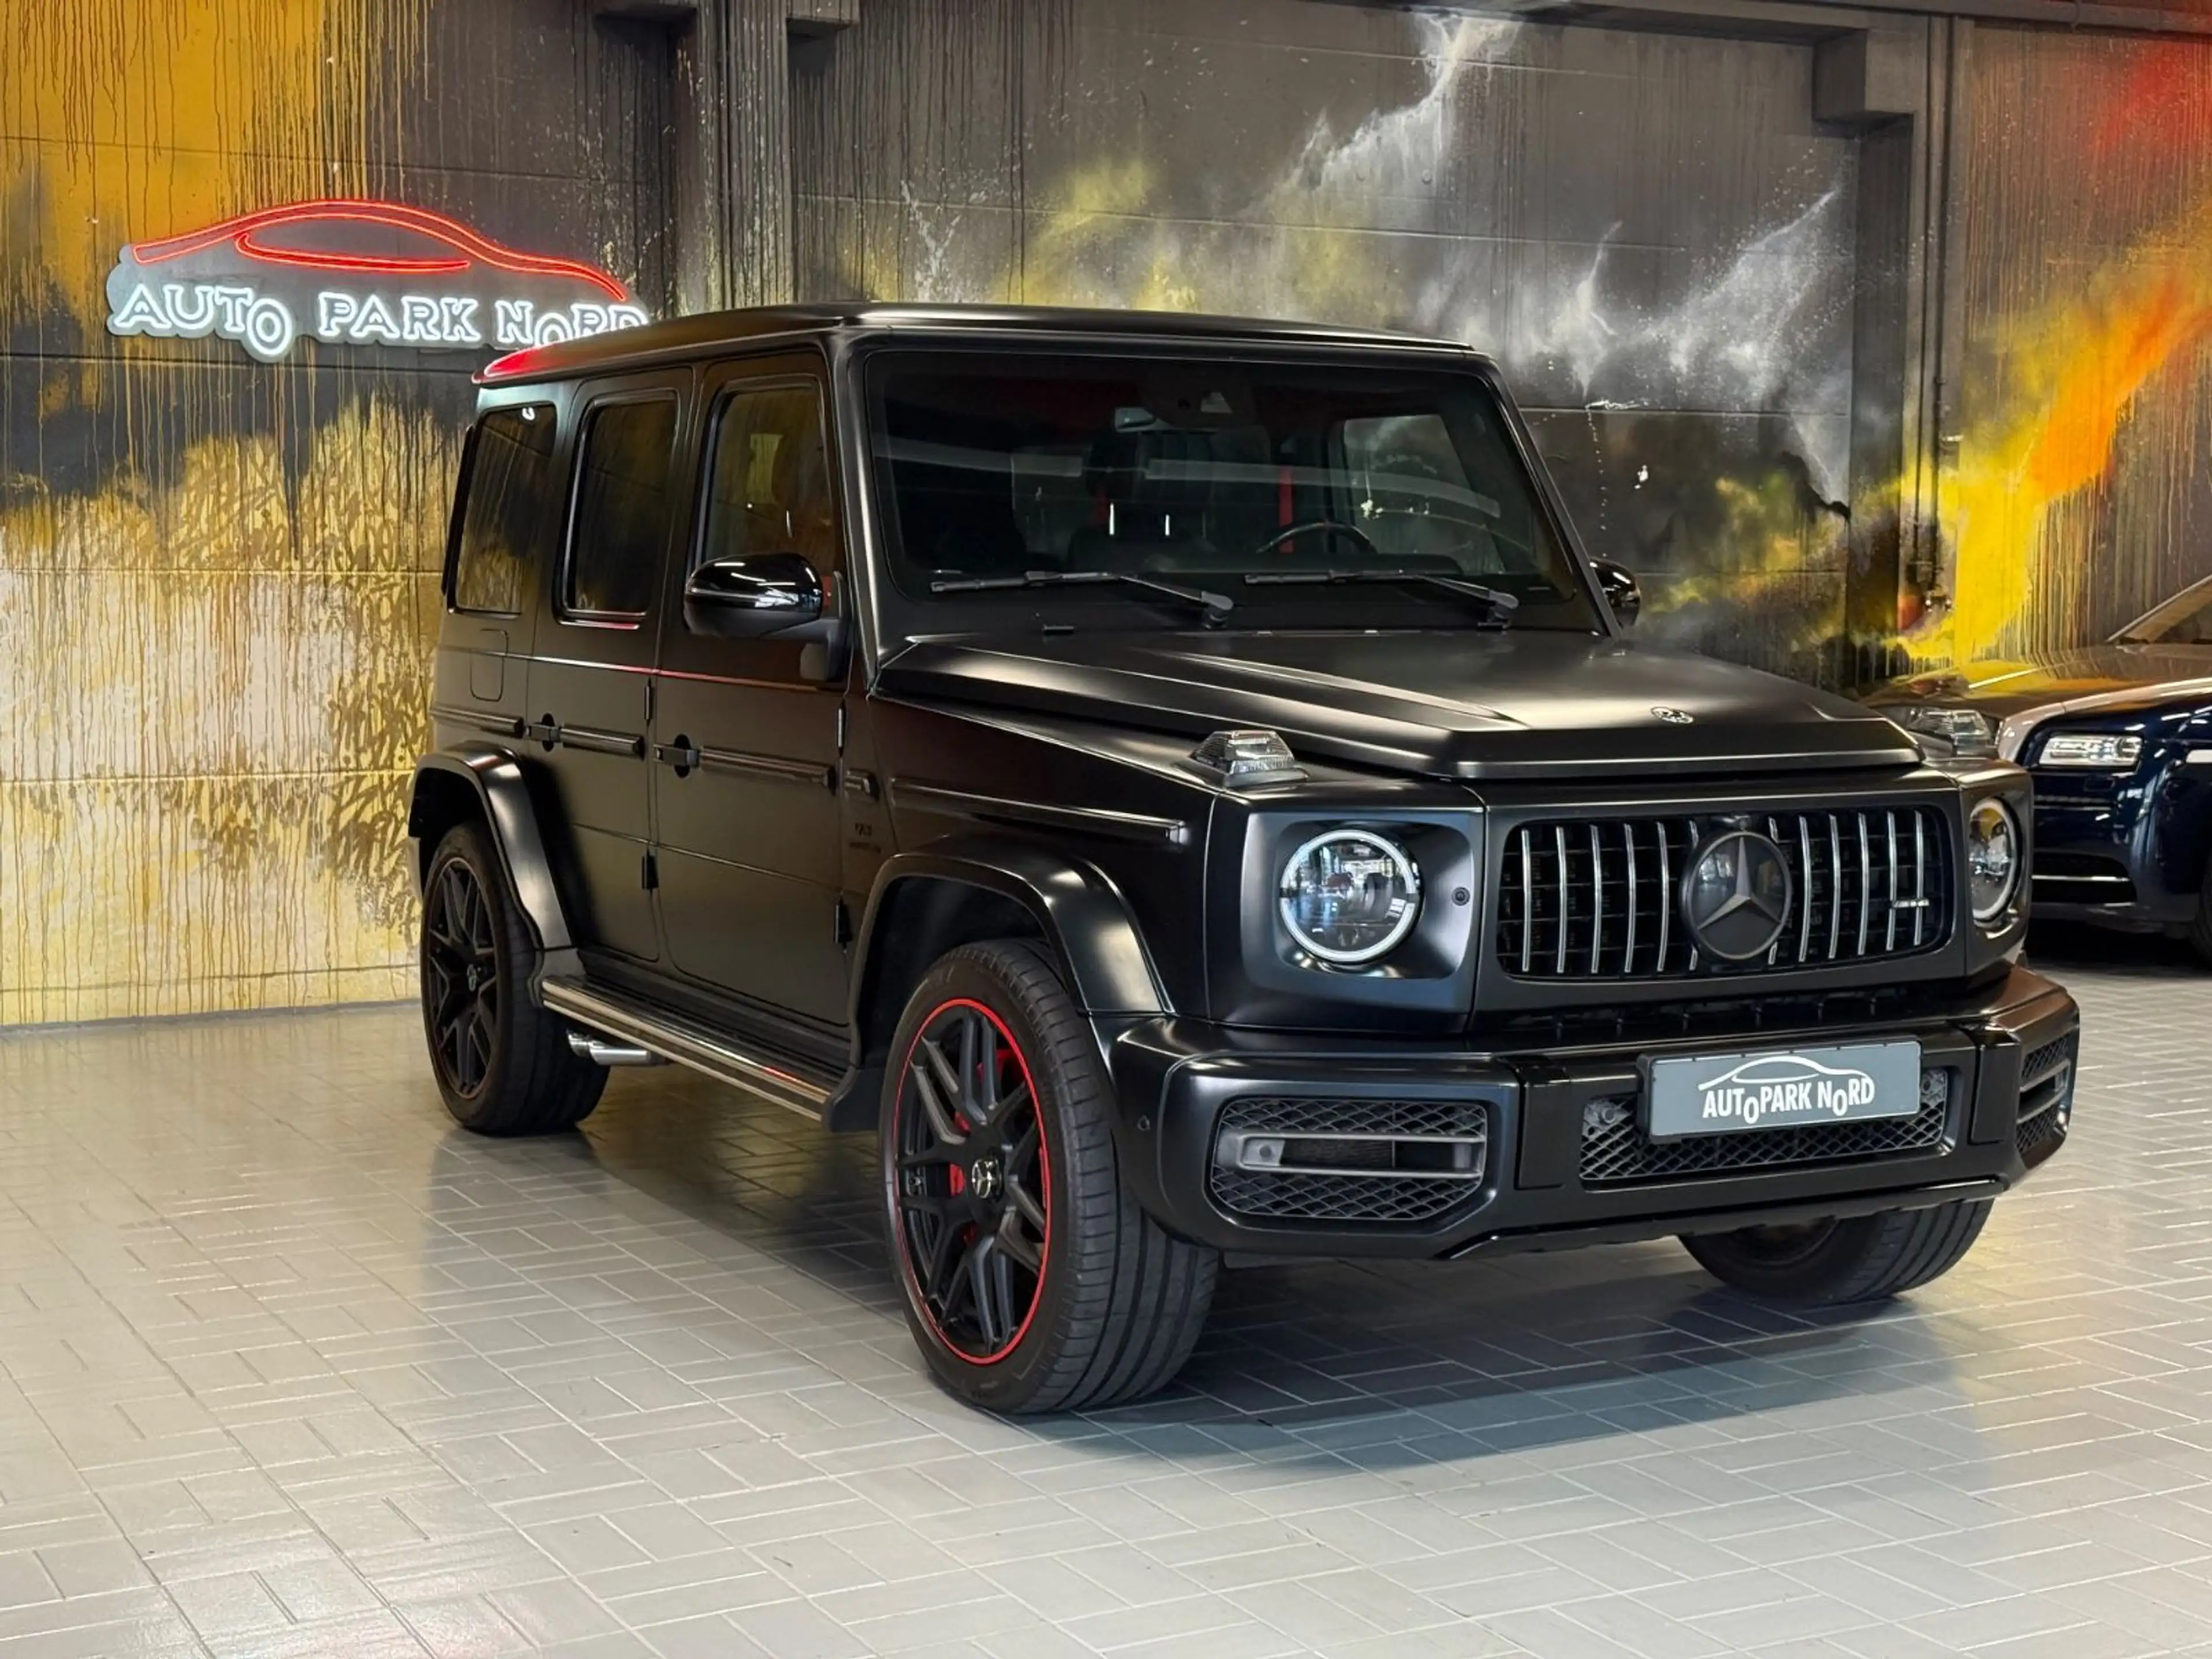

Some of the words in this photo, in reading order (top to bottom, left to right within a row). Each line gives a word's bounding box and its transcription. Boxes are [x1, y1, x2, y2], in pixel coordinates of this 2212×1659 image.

[113, 283, 293, 355] AUTO
[319, 291, 482, 342] PARK
[1817, 1078, 1875, 1116] NORD
